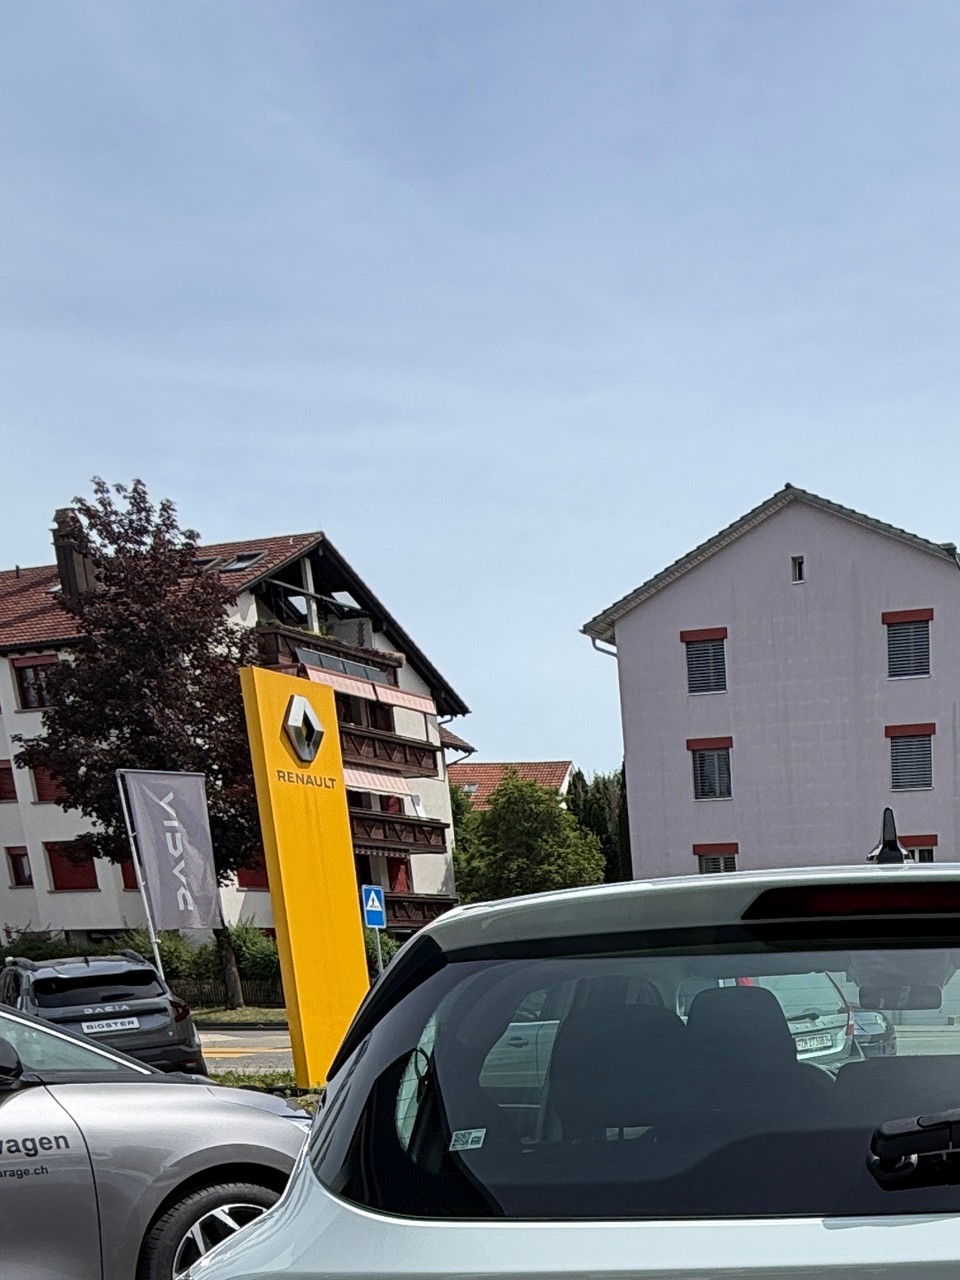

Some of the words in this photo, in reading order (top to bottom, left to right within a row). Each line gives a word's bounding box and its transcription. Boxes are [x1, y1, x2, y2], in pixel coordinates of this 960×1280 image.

[276, 769, 337, 790] RENAULT
[153, 791, 195, 912] DACIA
[83, 1004, 130, 1014] DACIA
[86, 1020, 135, 1030] BIGSTER
[0, 1135, 70, 1157] agen
